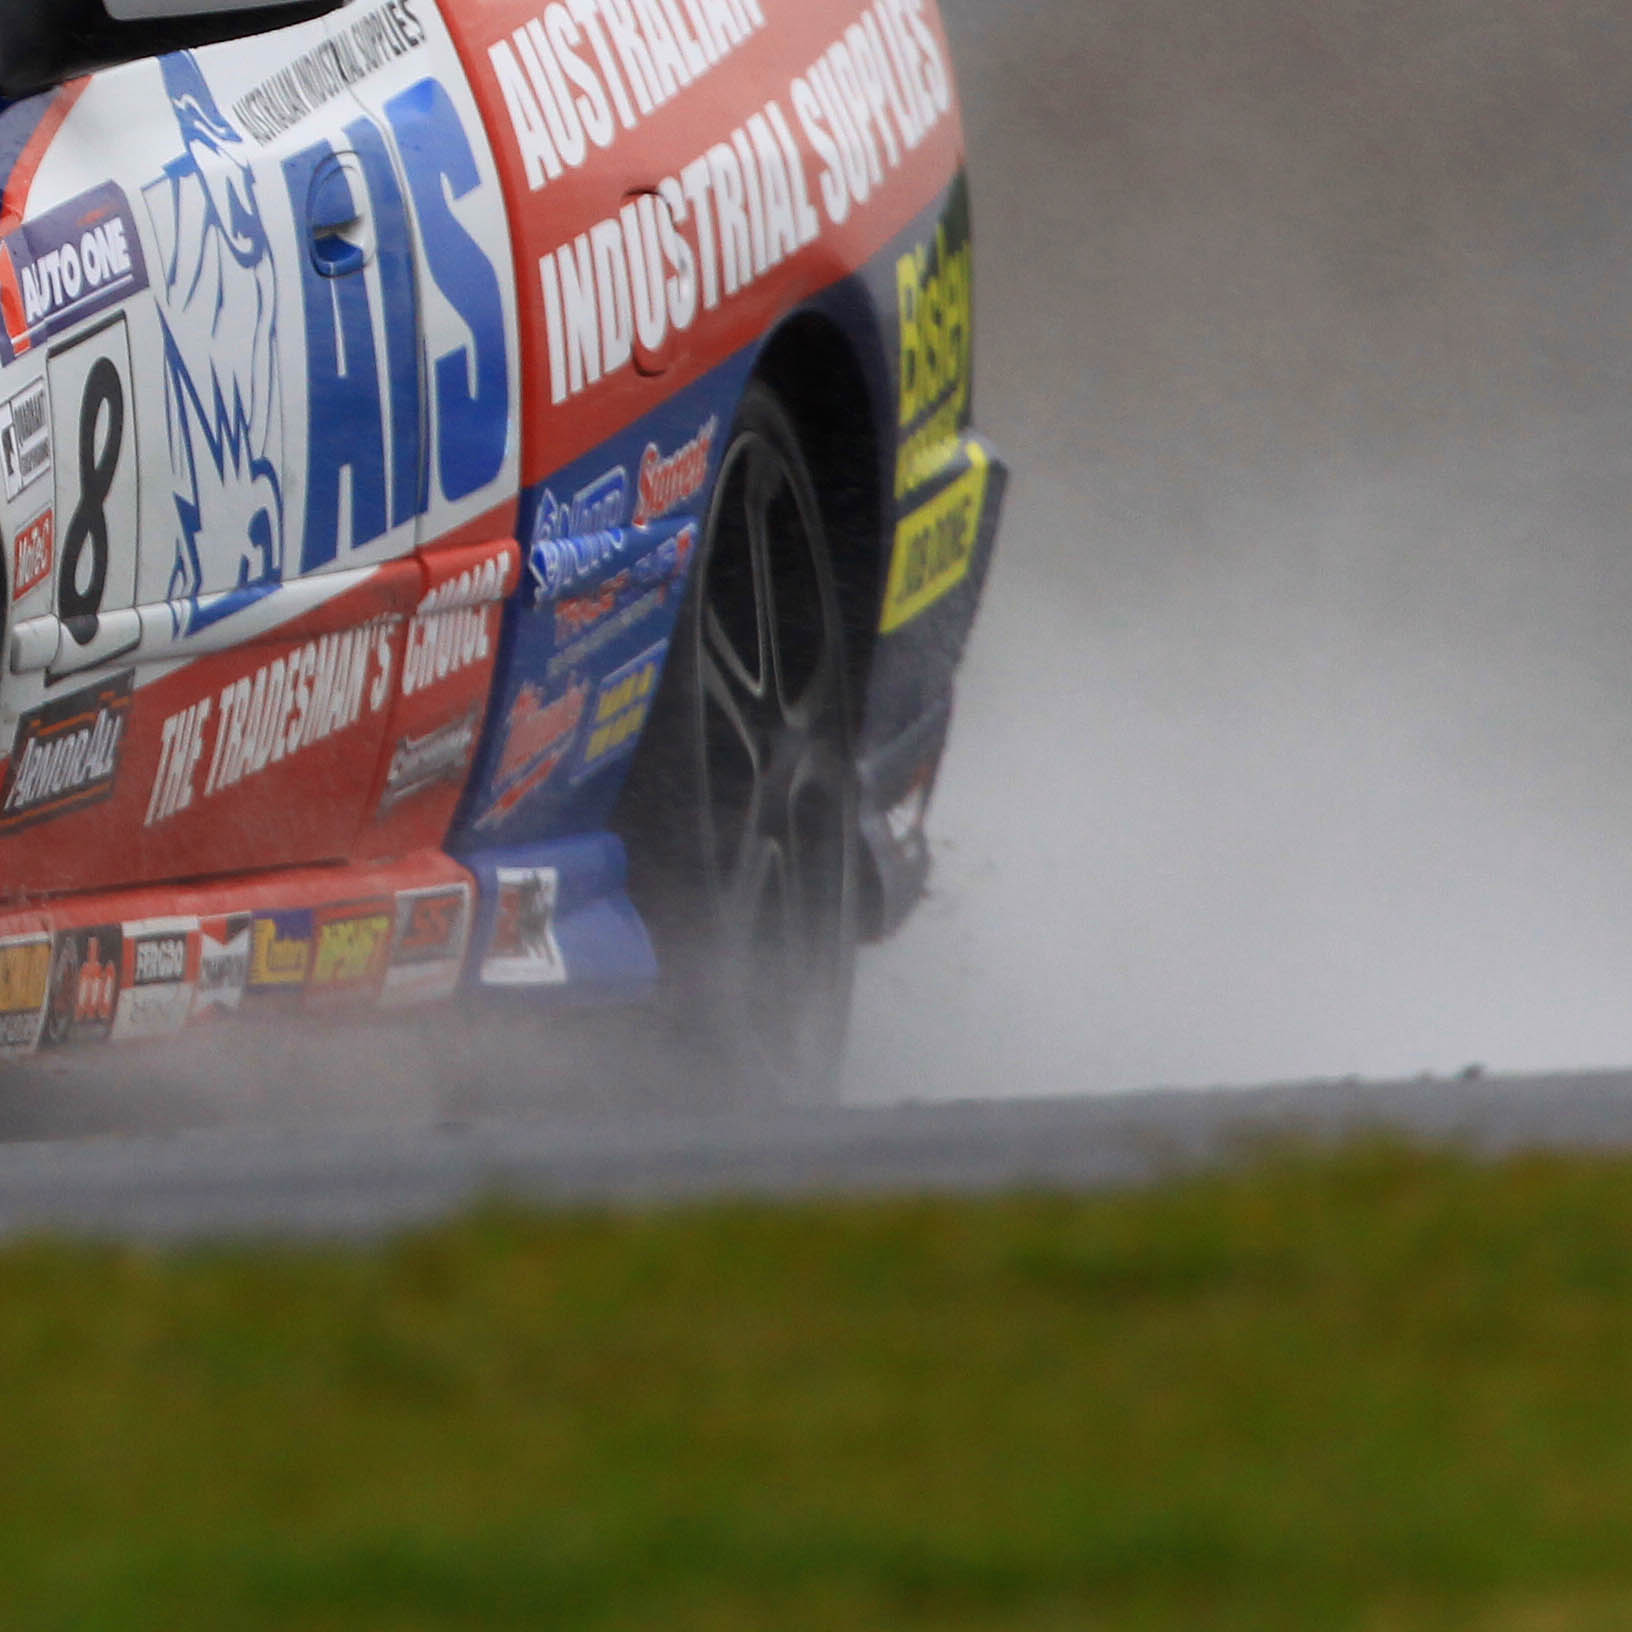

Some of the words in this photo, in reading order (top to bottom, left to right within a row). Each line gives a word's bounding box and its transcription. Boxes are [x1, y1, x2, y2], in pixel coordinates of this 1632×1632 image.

[21, 243, 82, 323] AUTO
[81, 217, 131, 286] ONE
[280, 77, 511, 575] AIS
[539, 100, 819, 404] INDUSTRIAL
[57, 356, 124, 645] 8
[144, 698, 213, 827] THE
